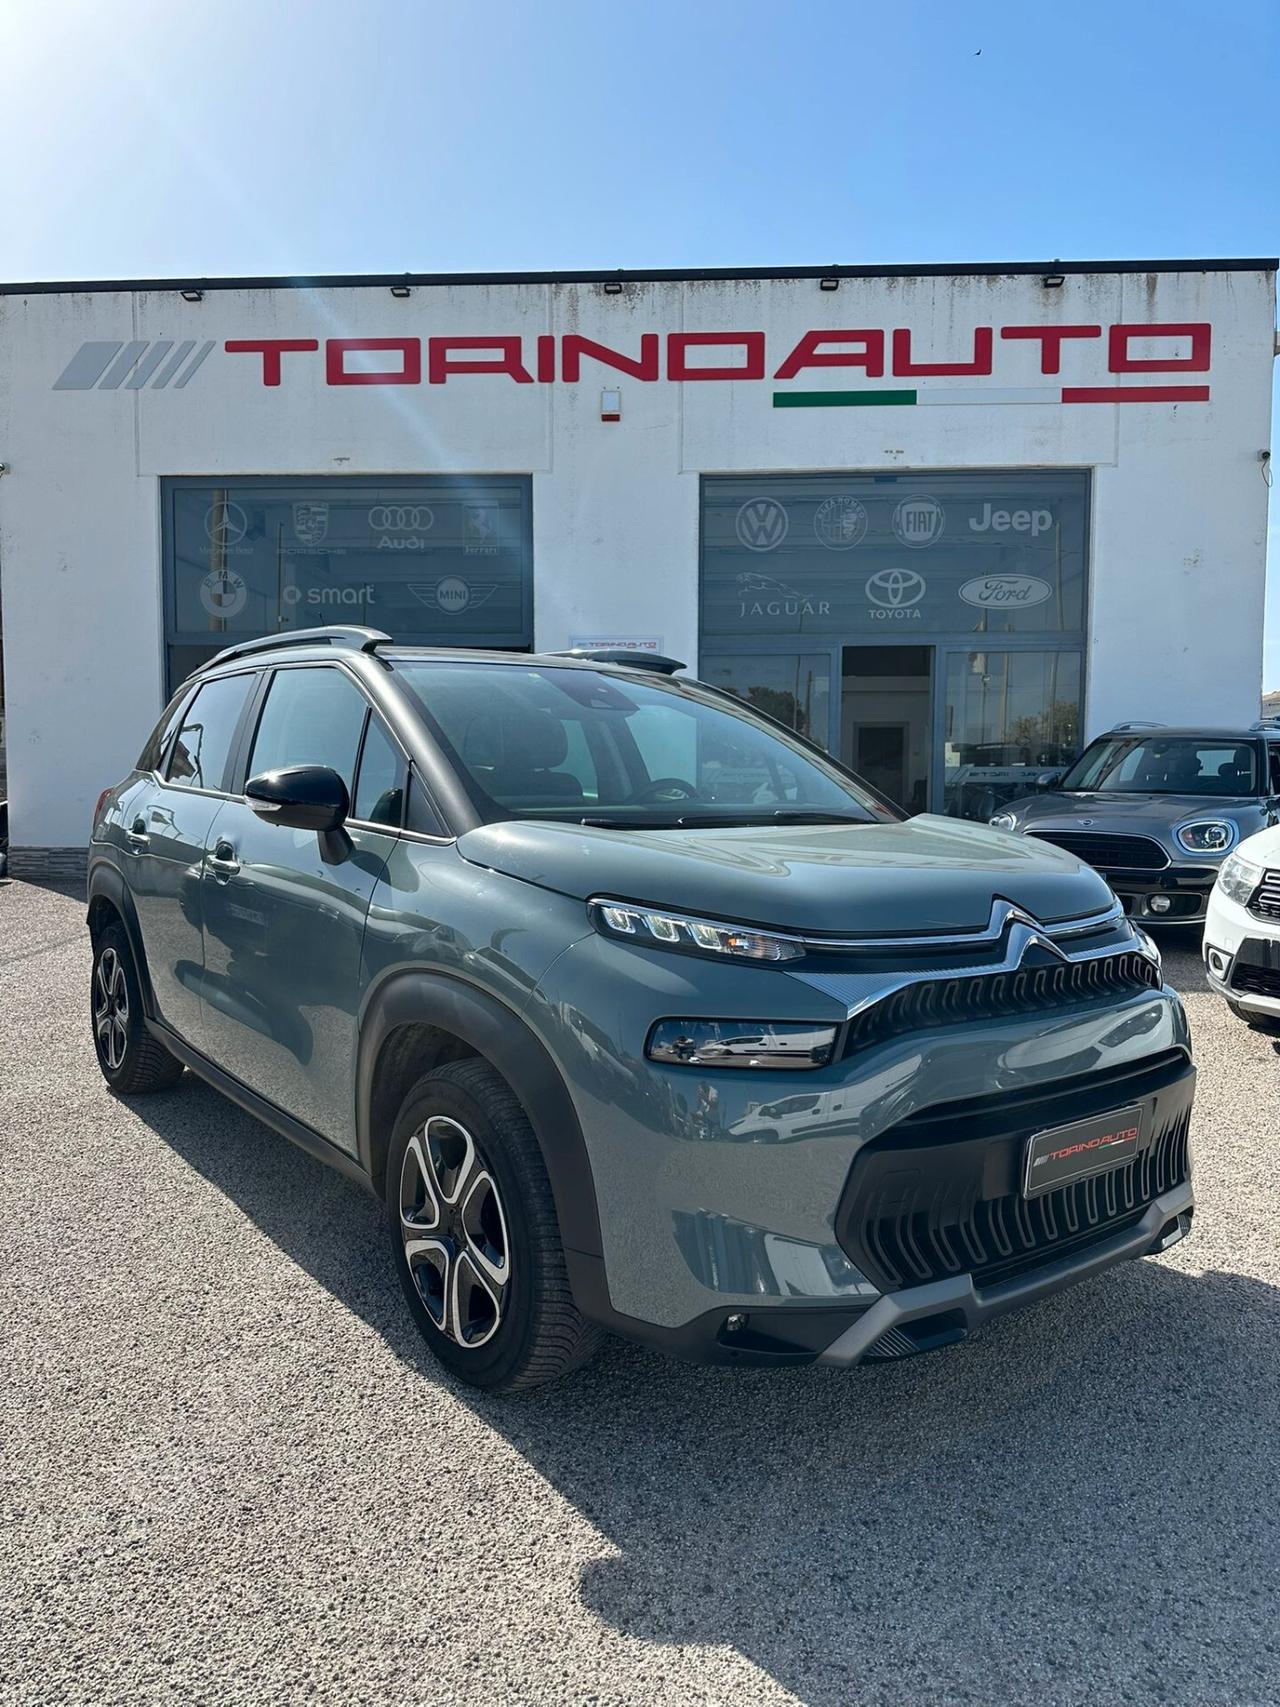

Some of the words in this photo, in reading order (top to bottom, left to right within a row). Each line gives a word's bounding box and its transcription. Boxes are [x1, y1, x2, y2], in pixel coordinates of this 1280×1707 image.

[225, 322, 1212, 387] TORINOAUTO
[905, 511, 935, 533] FIAT
[968, 503, 1053, 537] Jeep
[376, 535, 425, 549] Audi
[307, 584, 376, 605] smart
[439, 590, 466, 601] MINI
[978, 579, 1033, 602] Ford
[739, 601, 831, 618] JAGUAR
[868, 608, 922, 620] TOYOTA
[1048, 1127, 1138, 1160] TORINOAUTO
